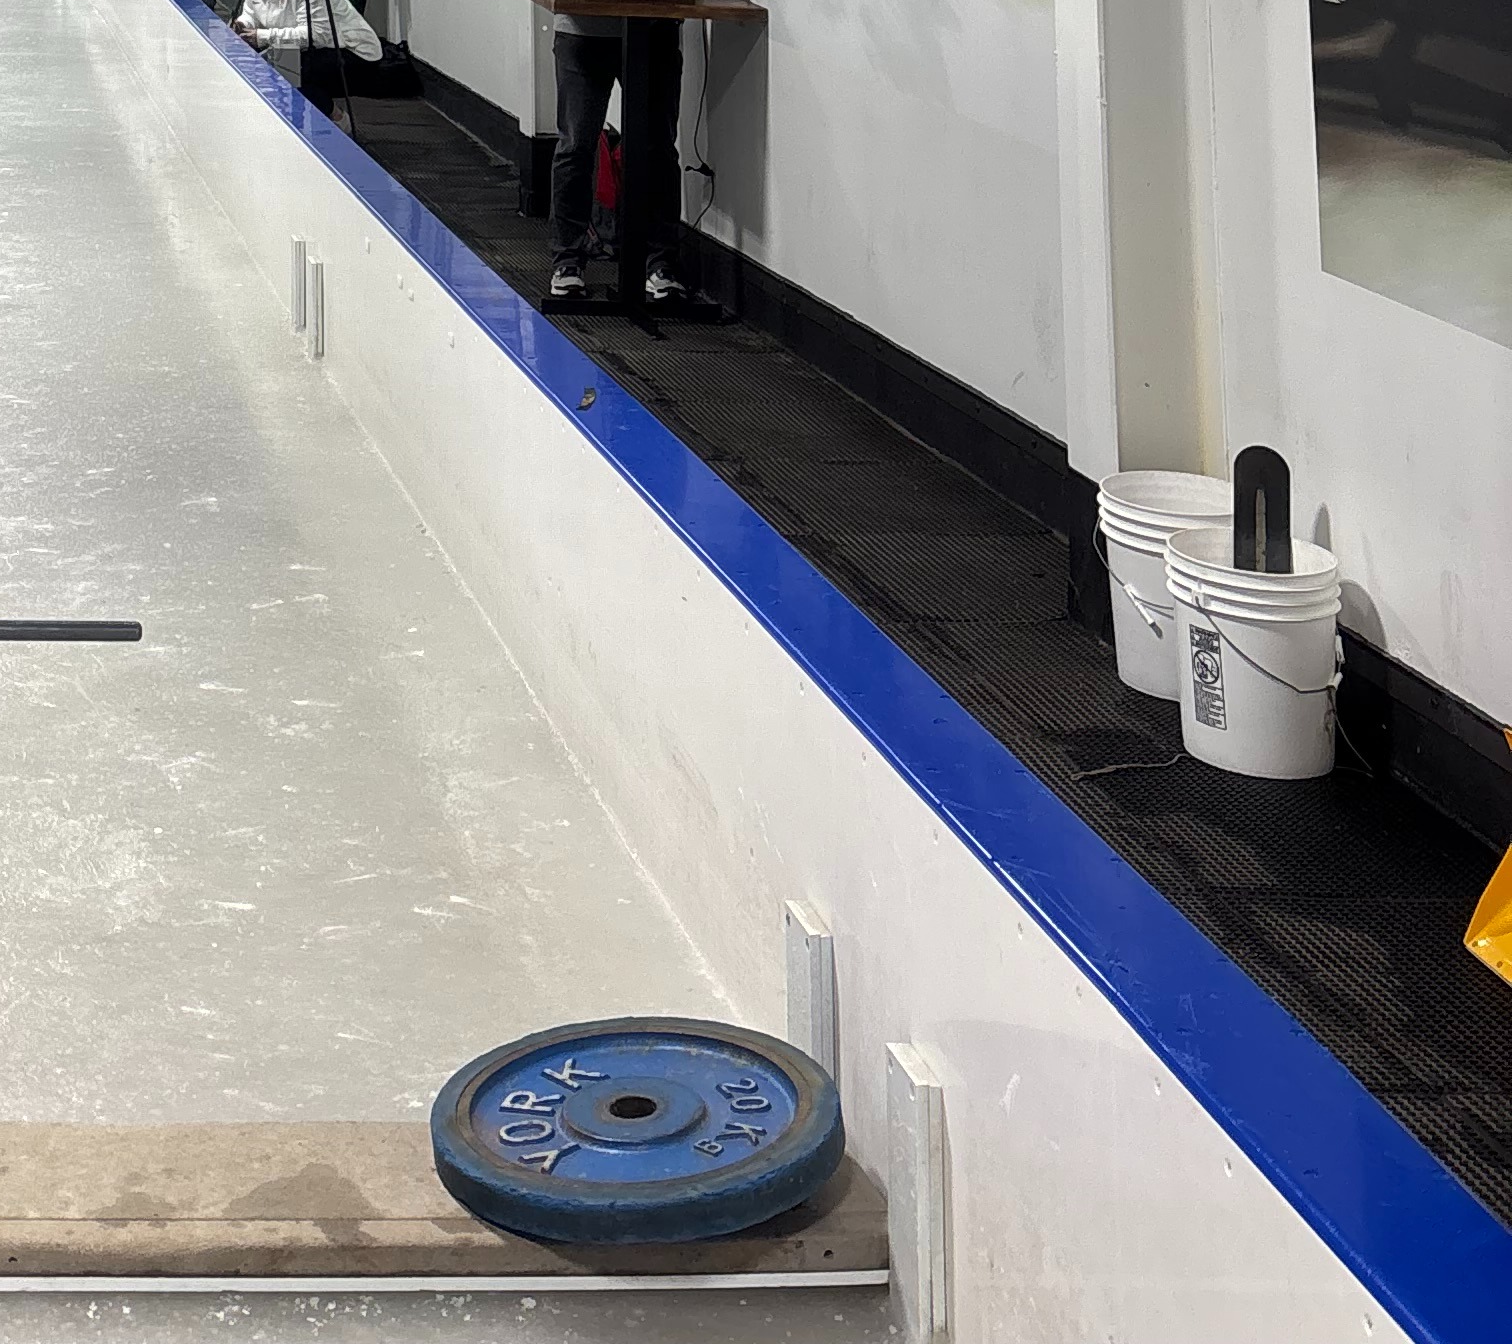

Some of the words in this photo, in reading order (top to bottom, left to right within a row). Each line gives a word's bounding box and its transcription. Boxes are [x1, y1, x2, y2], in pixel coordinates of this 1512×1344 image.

[717, 1078, 770, 1113] 20
[499, 1057, 607, 1173] YORK
[694, 1123, 766, 1156] Kg
